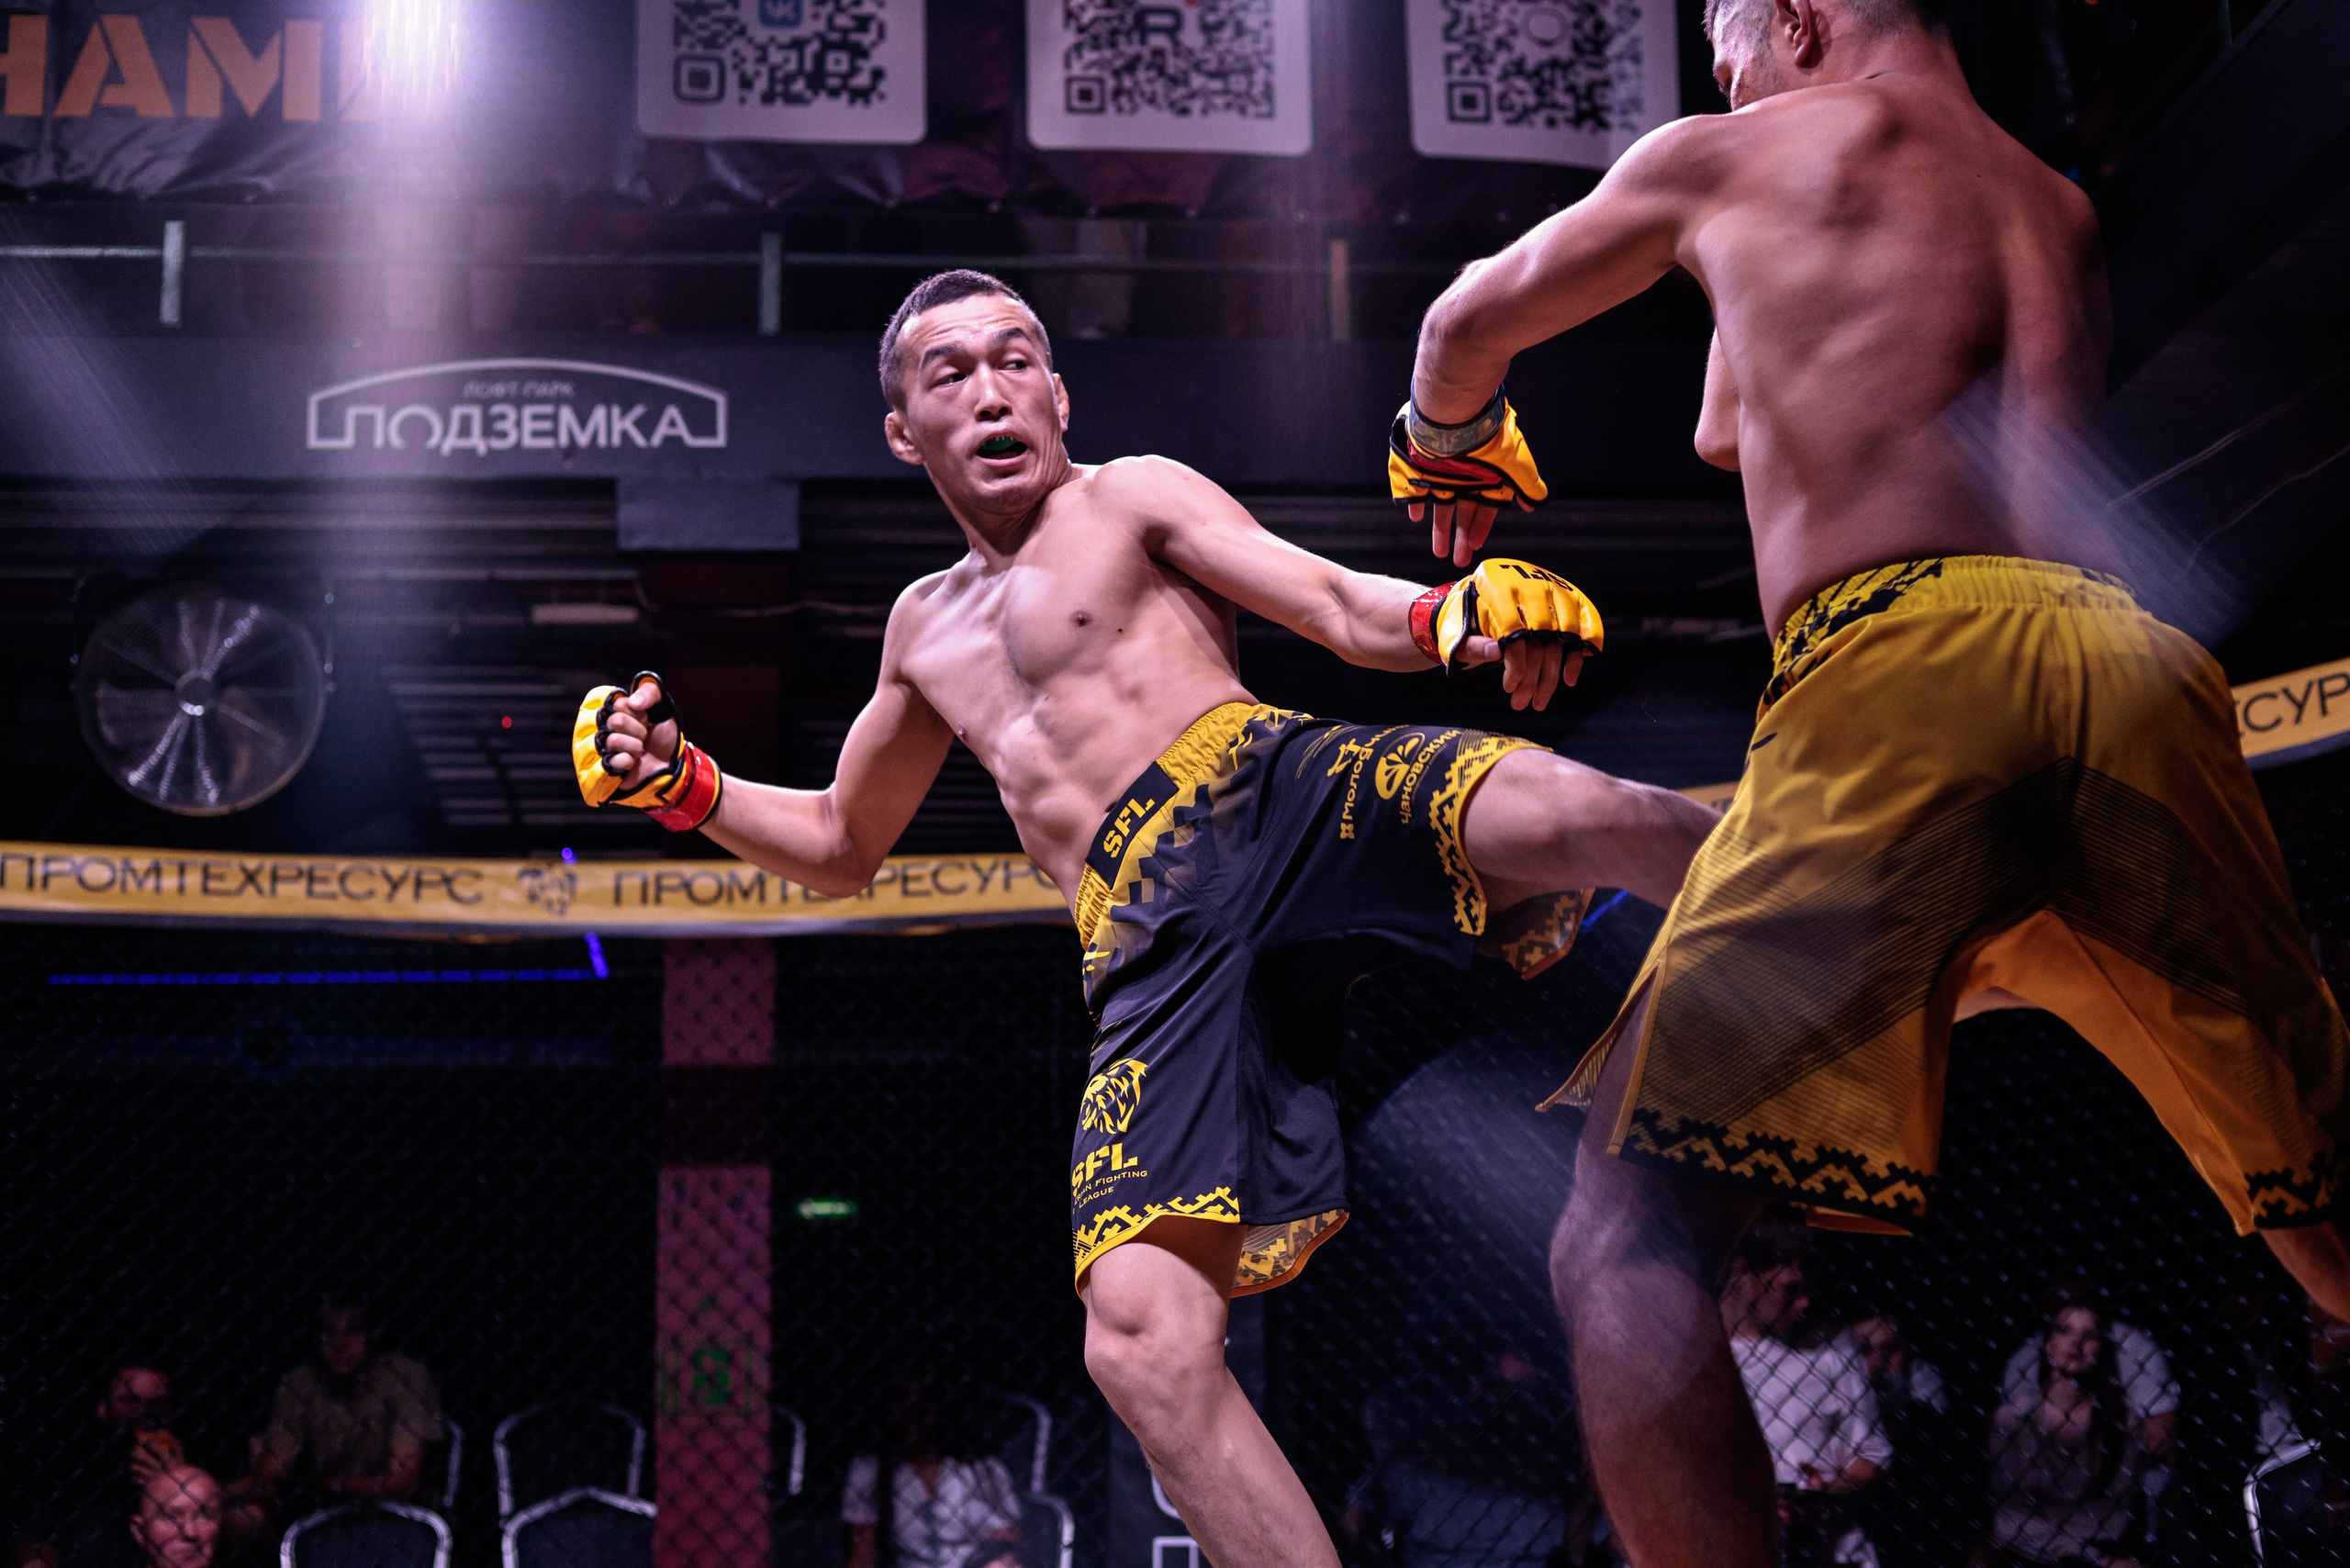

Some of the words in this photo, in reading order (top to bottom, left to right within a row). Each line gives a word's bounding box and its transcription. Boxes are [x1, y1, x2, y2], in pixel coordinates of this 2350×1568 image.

[345, 402, 695, 456] ПОДЗЕМКА
[2234, 672, 2350, 737] СУР
[1103, 799, 1155, 858] SFL
[0, 852, 483, 905] ПРОМТЕХРЕСУРС
[1071, 1143, 1138, 1197] SFL
[1079, 1186, 1114, 1208] LEAGUE
[1095, 1170, 1147, 1187] FIGHTING
